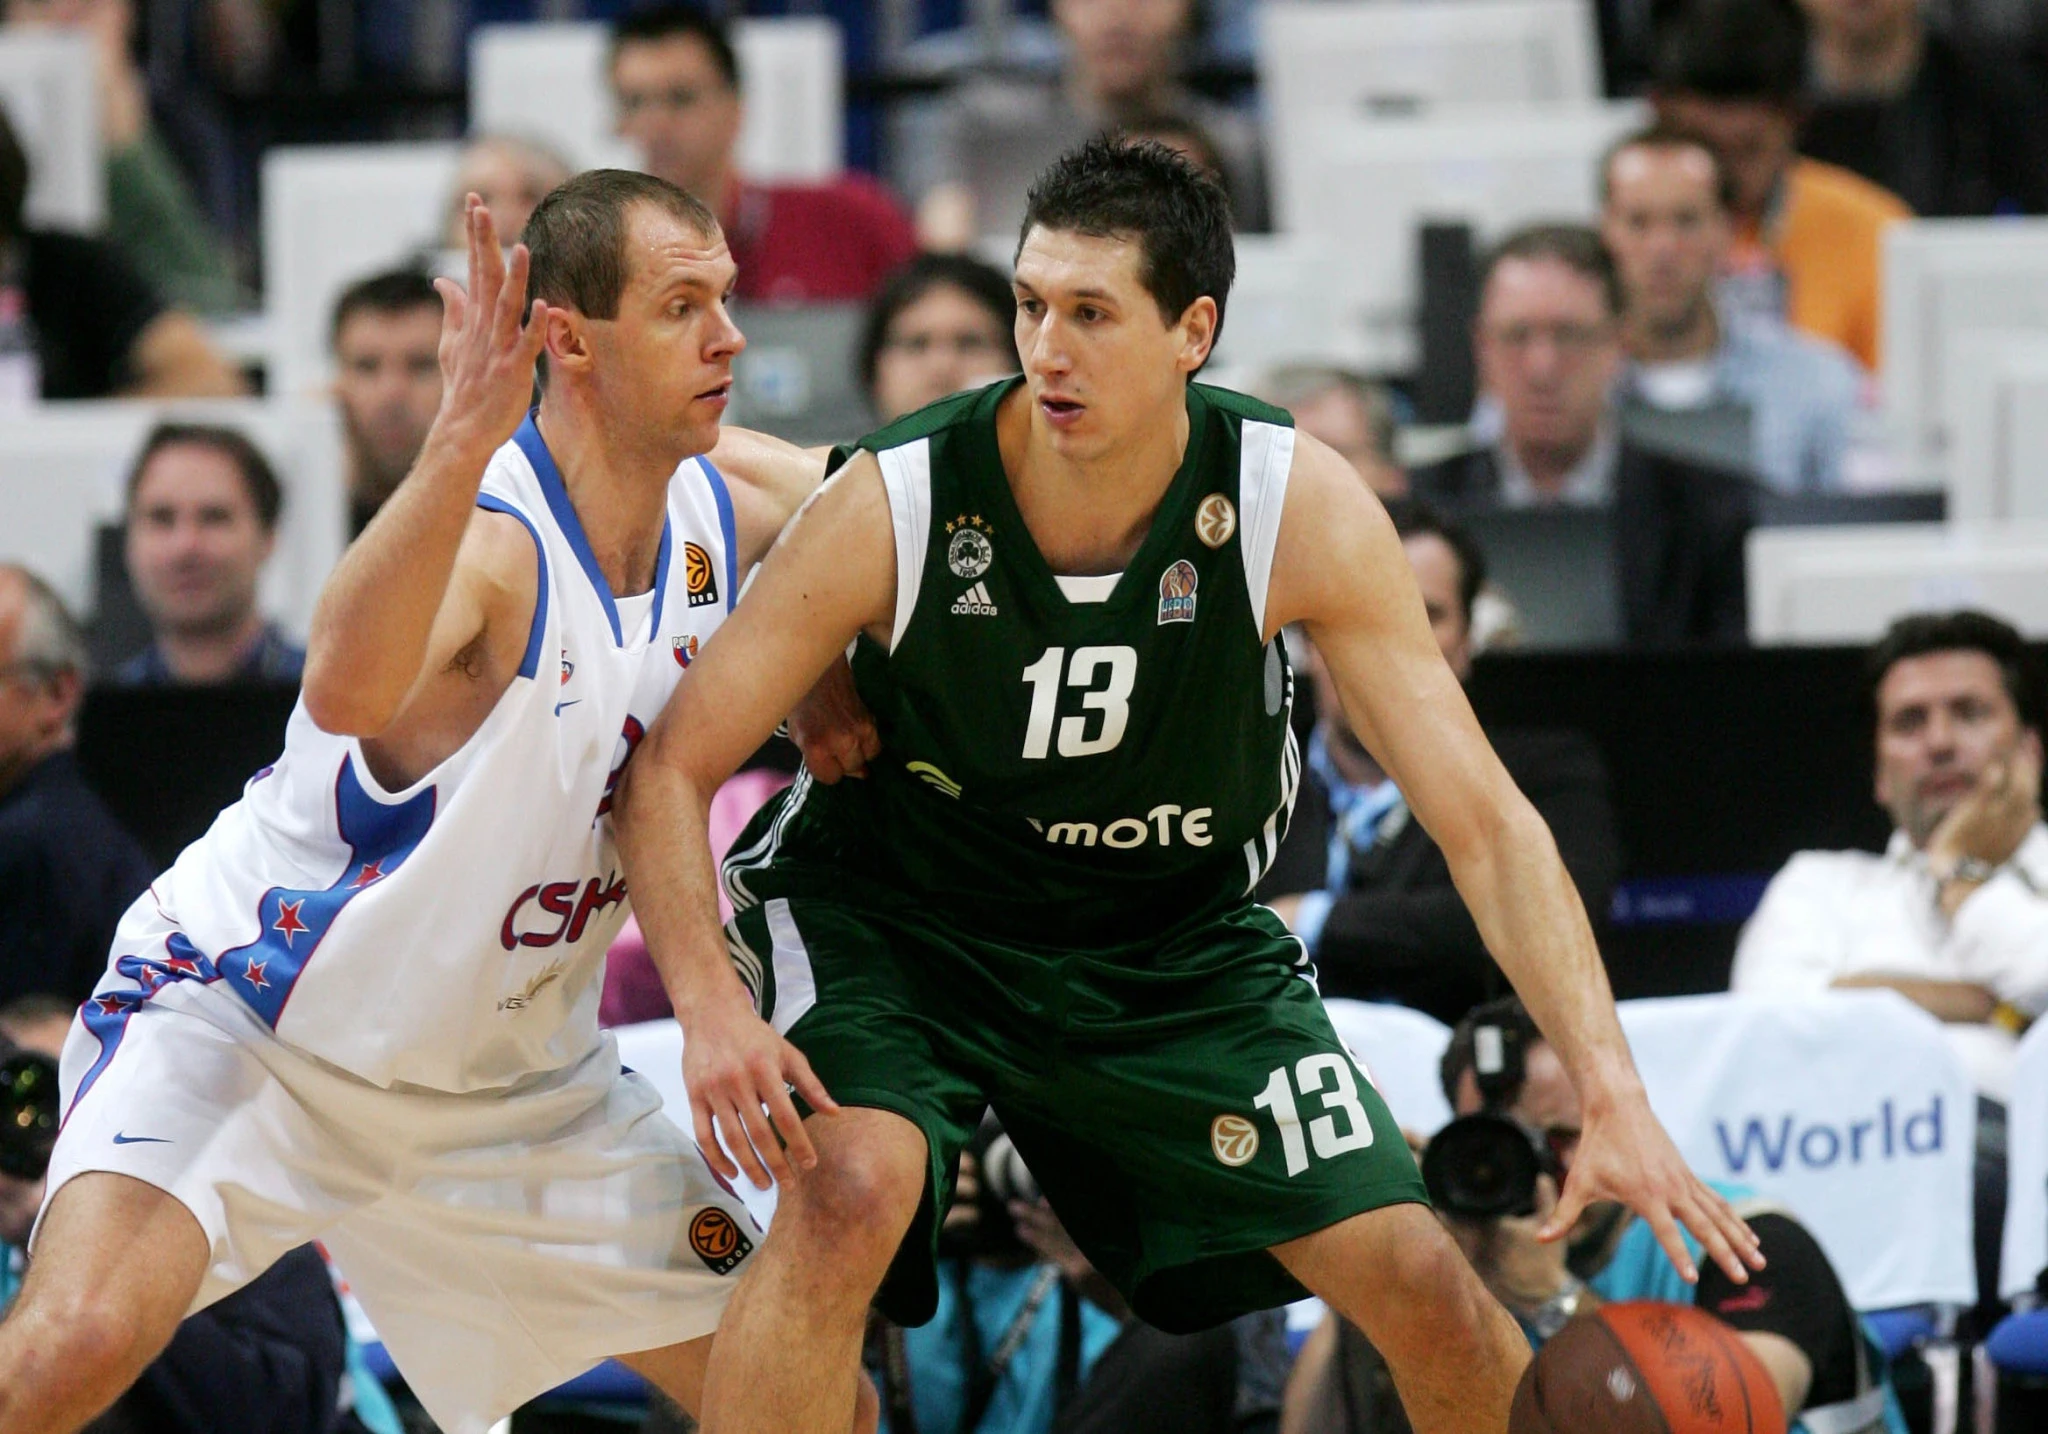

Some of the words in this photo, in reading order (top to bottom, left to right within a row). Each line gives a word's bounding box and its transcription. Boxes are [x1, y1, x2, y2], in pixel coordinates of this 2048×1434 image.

[950, 602, 998, 616] adidas
[1021, 645, 1138, 760] 13
[1252, 1052, 1375, 1178] 13
[1715, 1090, 1944, 1173] World
